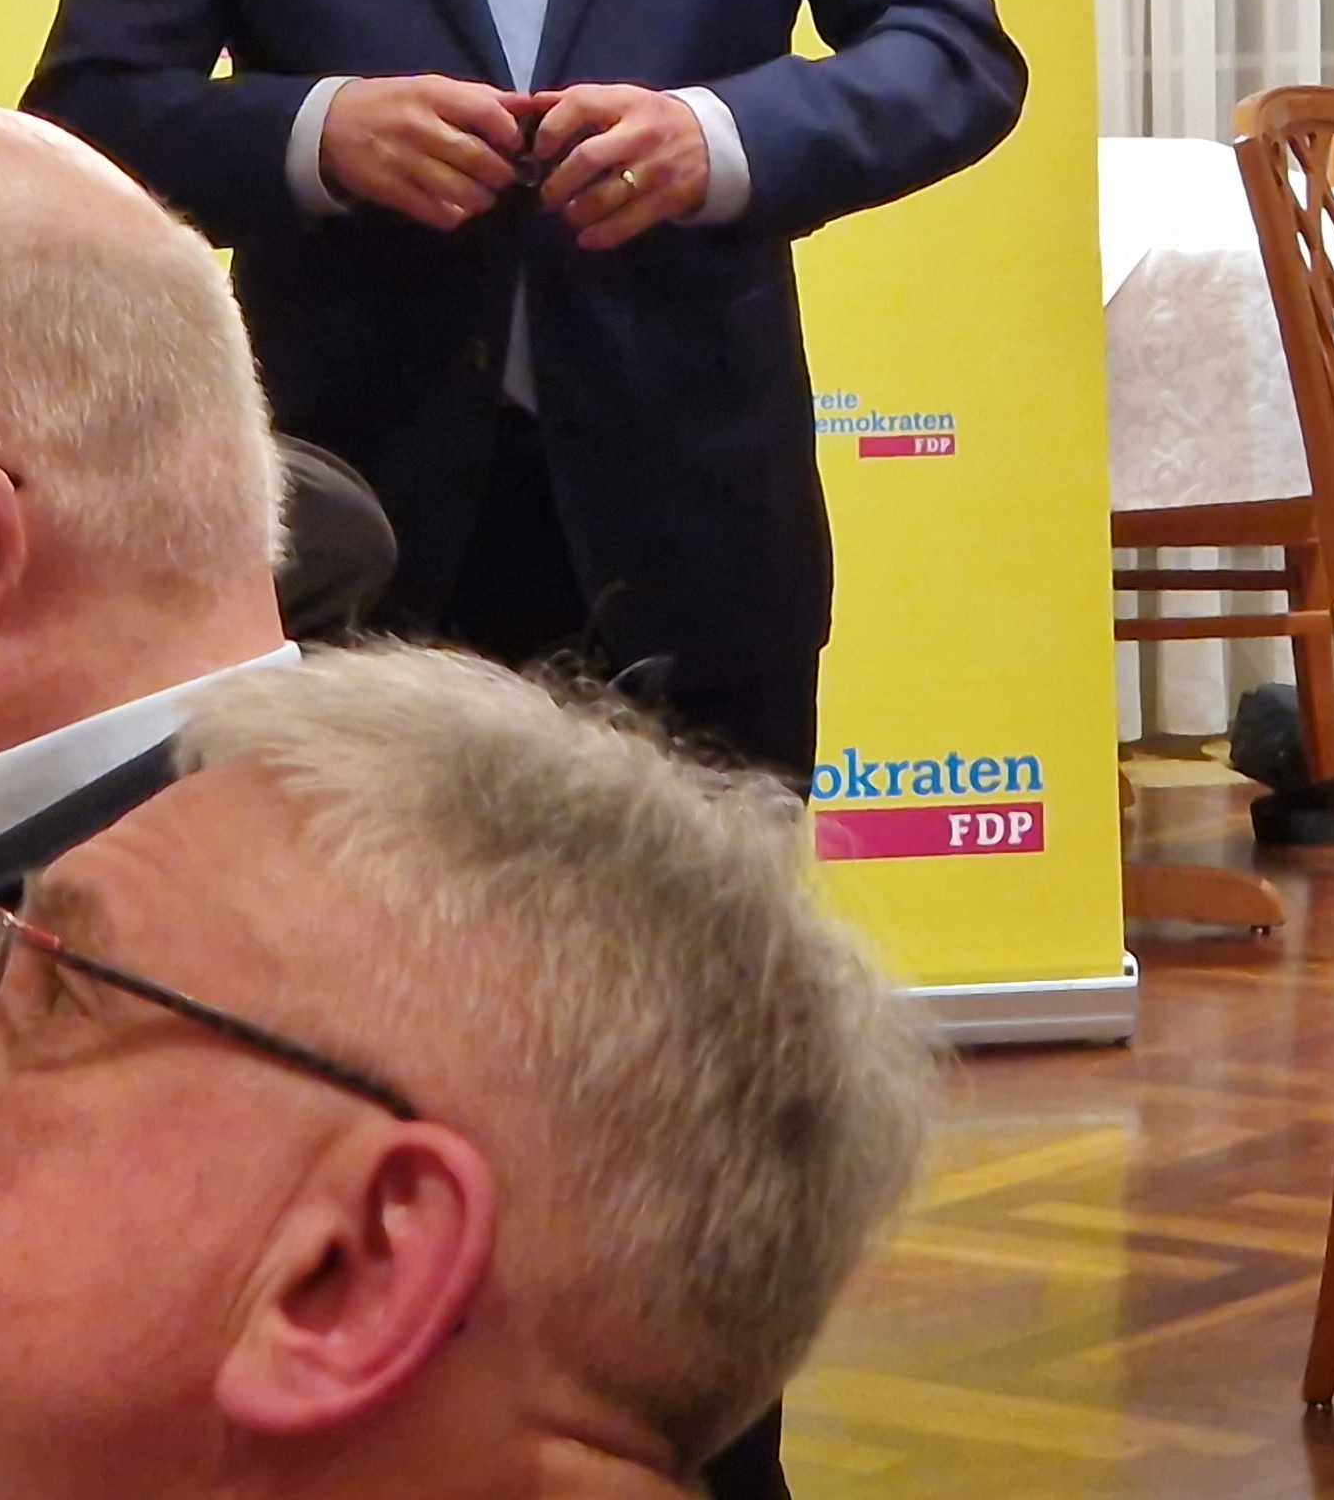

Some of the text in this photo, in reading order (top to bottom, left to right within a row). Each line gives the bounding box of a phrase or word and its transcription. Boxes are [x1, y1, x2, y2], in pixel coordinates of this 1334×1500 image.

[814, 410, 955, 434] emokraten
[914, 437, 952, 454] FDP
[811, 747, 1044, 800] okraten
[948, 811, 1034, 847] FDP
